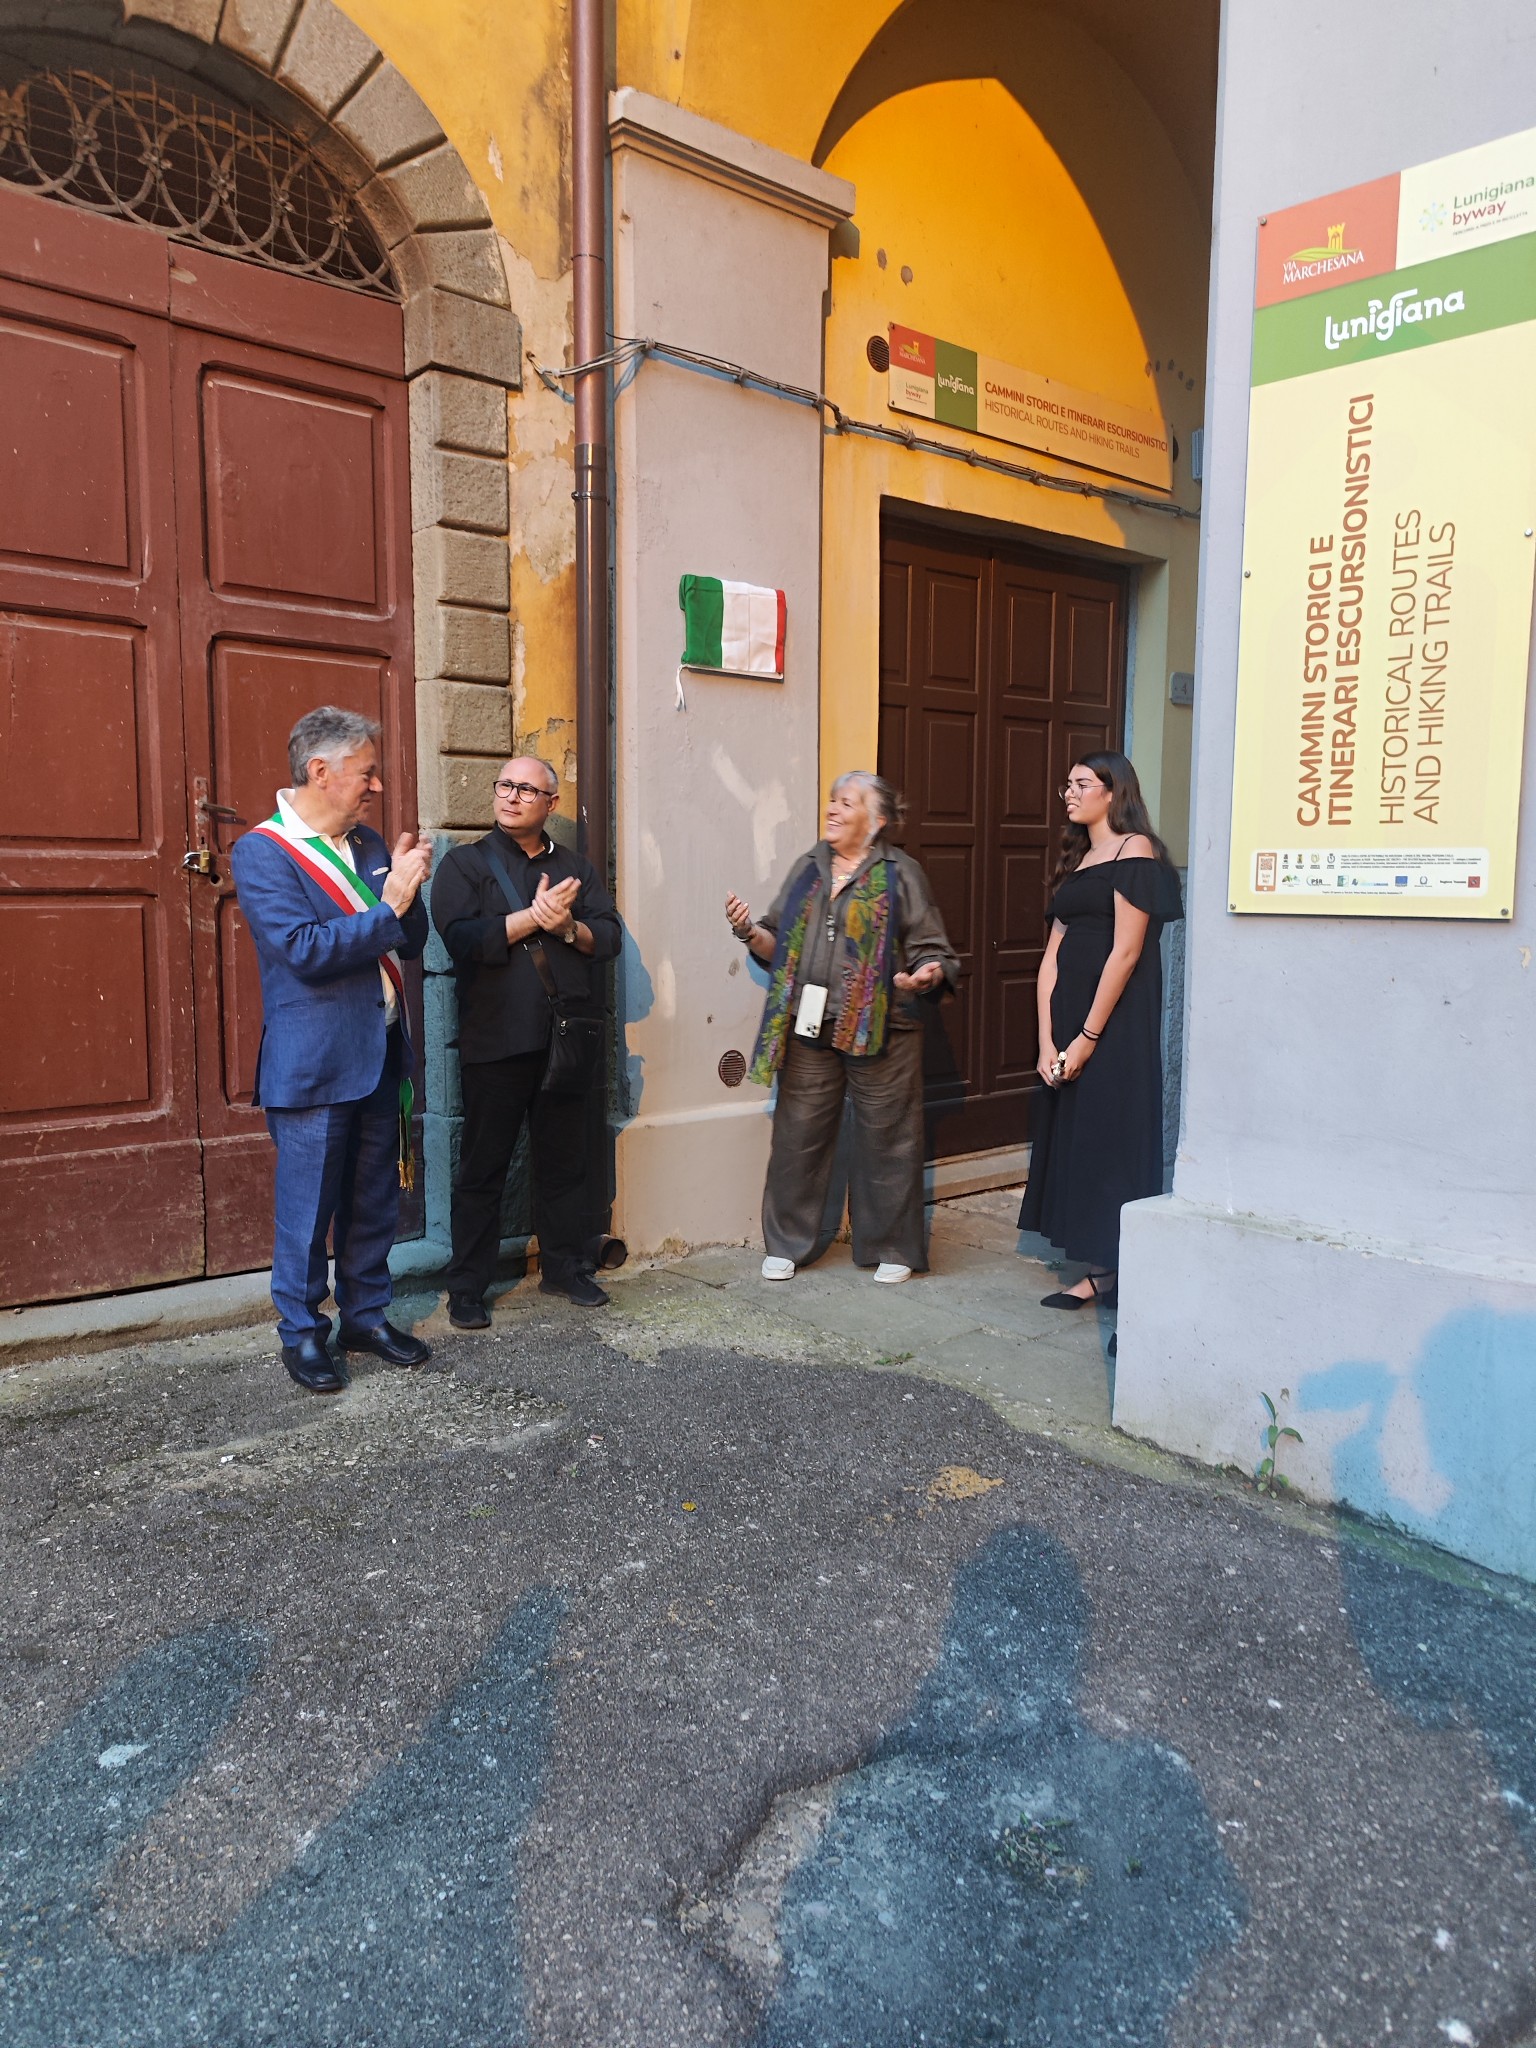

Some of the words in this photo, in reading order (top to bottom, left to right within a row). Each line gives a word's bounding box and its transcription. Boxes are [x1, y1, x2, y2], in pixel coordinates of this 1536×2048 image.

[1453, 200, 1506, 226] byway
[1454, 176, 1536, 209] Lunigiana
[1283, 261, 1297, 272] VIA
[1283, 250, 1365, 285] MARCHESANA
[985, 381, 1024, 404] CAMMINI
[1026, 395, 1059, 415] STORICI
[1060, 406, 1066, 418] E
[1067, 408, 1105, 431] ITINERARI
[1107, 422, 1168, 453] ESCURSIONISTICI
[985, 399, 1035, 425] HISTORICAL
[1036, 414, 1069, 435] ROUTES
[1070, 426, 1088, 441] AND
[1088, 431, 1114, 450] HIKING
[1115, 440, 1140, 458] TRAILS
[1310, 534, 1333, 554] E
[1335, 393, 1374, 667] ESCURSIONISTICI
[1389, 509, 1421, 637] ROUTES
[1303, 561, 1332, 684] STORICI
[1423, 521, 1456, 635] TRAILS
[1379, 643, 1413, 824] HISTORICAL
[1417, 640, 1449, 746] HIKING
[1297, 691, 1326, 827] CAMMINI
[1327, 675, 1359, 826] ITINERARI
[1413, 755, 1441, 825] AND
